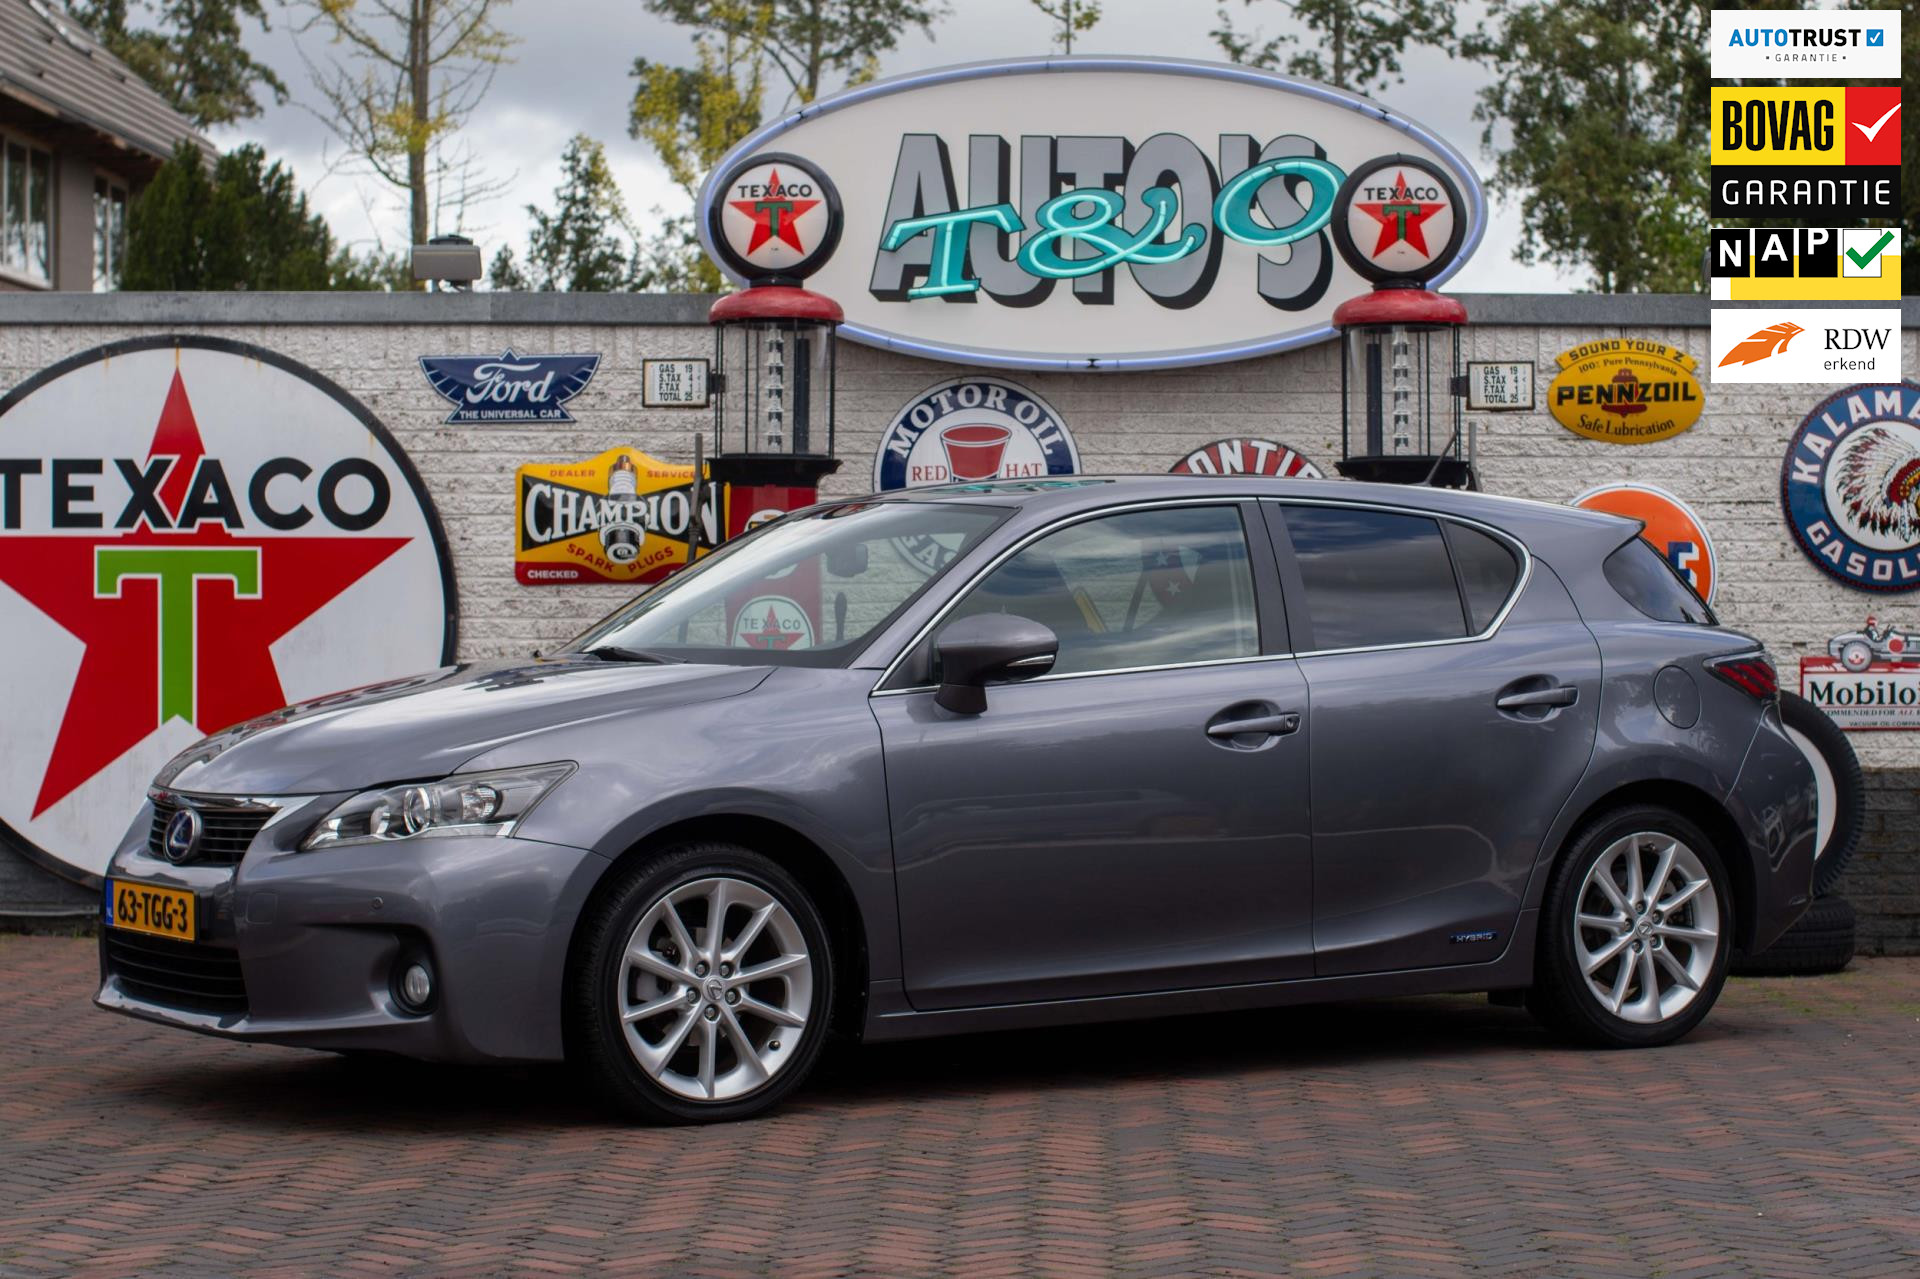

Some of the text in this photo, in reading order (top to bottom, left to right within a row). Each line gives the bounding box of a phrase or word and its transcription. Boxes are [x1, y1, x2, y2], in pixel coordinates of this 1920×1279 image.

[738, 184, 812, 198] TEXACO
[1364, 187, 1438, 200] TEXACO
[755, 201, 793, 236] T
[869, 133, 1332, 309] AUTO'S
[1383, 204, 1420, 240] T
[1569, 340, 1684, 362] SOUND YOUR Z
[659, 364, 693, 373] GAS 19
[1484, 366, 1518, 375] GAS 19
[1603, 358, 1623, 366] Pure
[1624, 357, 1677, 376] Pennsylvania
[466, 363, 556, 404] Ford
[659, 374, 681, 382] S.TAX
[659, 383, 680, 391] F.TAX
[1484, 376, 1506, 384] S.TAX
[1513, 376, 1518, 384] 4
[659, 392, 682, 401] TOTAL
[684, 392, 693, 401] 25
[1484, 385, 1505, 393] F.TAX
[1557, 382, 1696, 406] PENNZOIL
[1484, 395, 1507, 403] TOTAL
[1510, 394, 1519, 403] 25
[459, 409, 561, 419] THE UNIVERSAL CAR
[888, 384, 1064, 458] MOTOR OIL
[1578, 414, 1675, 436] Safe Lubrication
[550, 469, 596, 477] DEALER
[912, 463, 1043, 481] RED HAT
[0, 457, 391, 531] TEXACO
[566, 543, 675, 573] SPARK PLUGS
[1806, 520, 1920, 581] GASOL
[528, 570, 579, 579] CHECKED
[743, 618, 801, 630] TEXACO
[94, 545, 262, 727] T
[1809, 680, 1920, 705] Mobilo
[118, 888, 188, 933] 63-TGG-3
